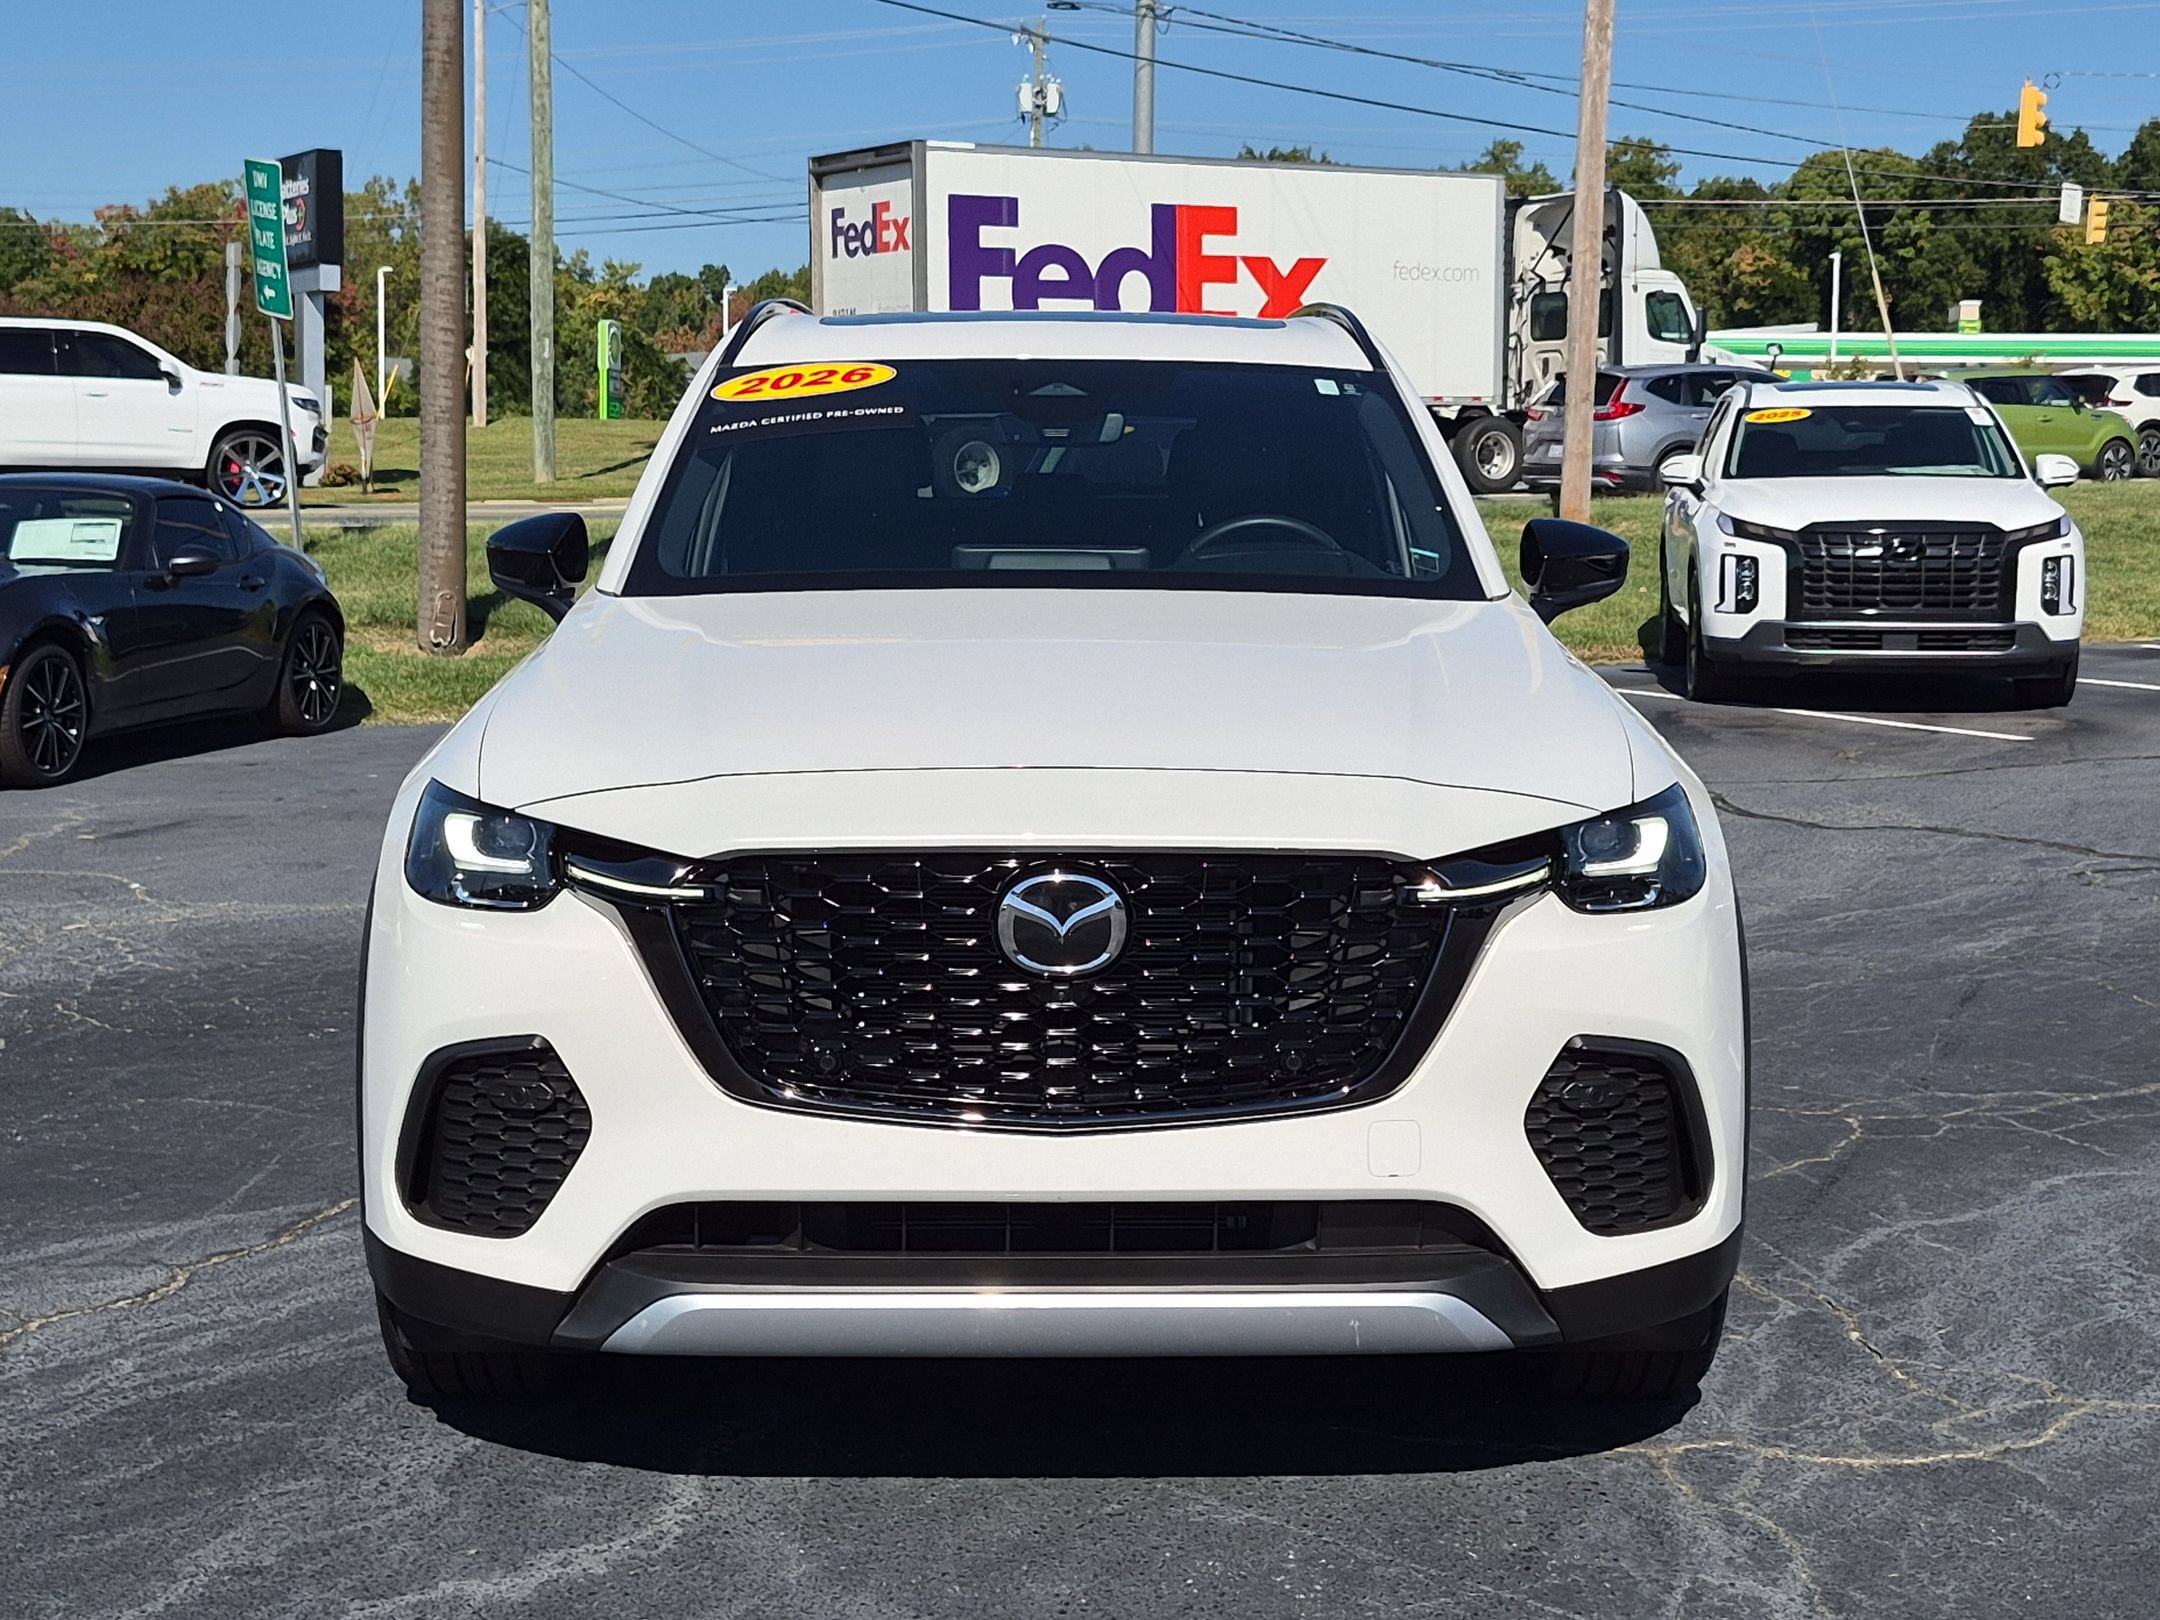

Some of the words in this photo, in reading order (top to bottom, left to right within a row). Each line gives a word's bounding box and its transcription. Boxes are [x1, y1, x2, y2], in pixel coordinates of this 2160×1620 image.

[252, 170, 268, 189] DMV
[250, 198, 278, 220] LICENSE
[254, 228, 275, 250] PLATE
[831, 200, 911, 259] FedEx
[948, 194, 1329, 319] FedEx
[256, 257, 282, 280] AGENCY
[1393, 260, 1480, 281] fedex.com
[731, 367, 876, 397] 2026
[709, 419, 758, 434] MAZDA
[761, 411, 823, 426] CERTIFIED
[826, 406, 904, 419] PRE-OWNED
[1754, 411, 1802, 420] 2025
